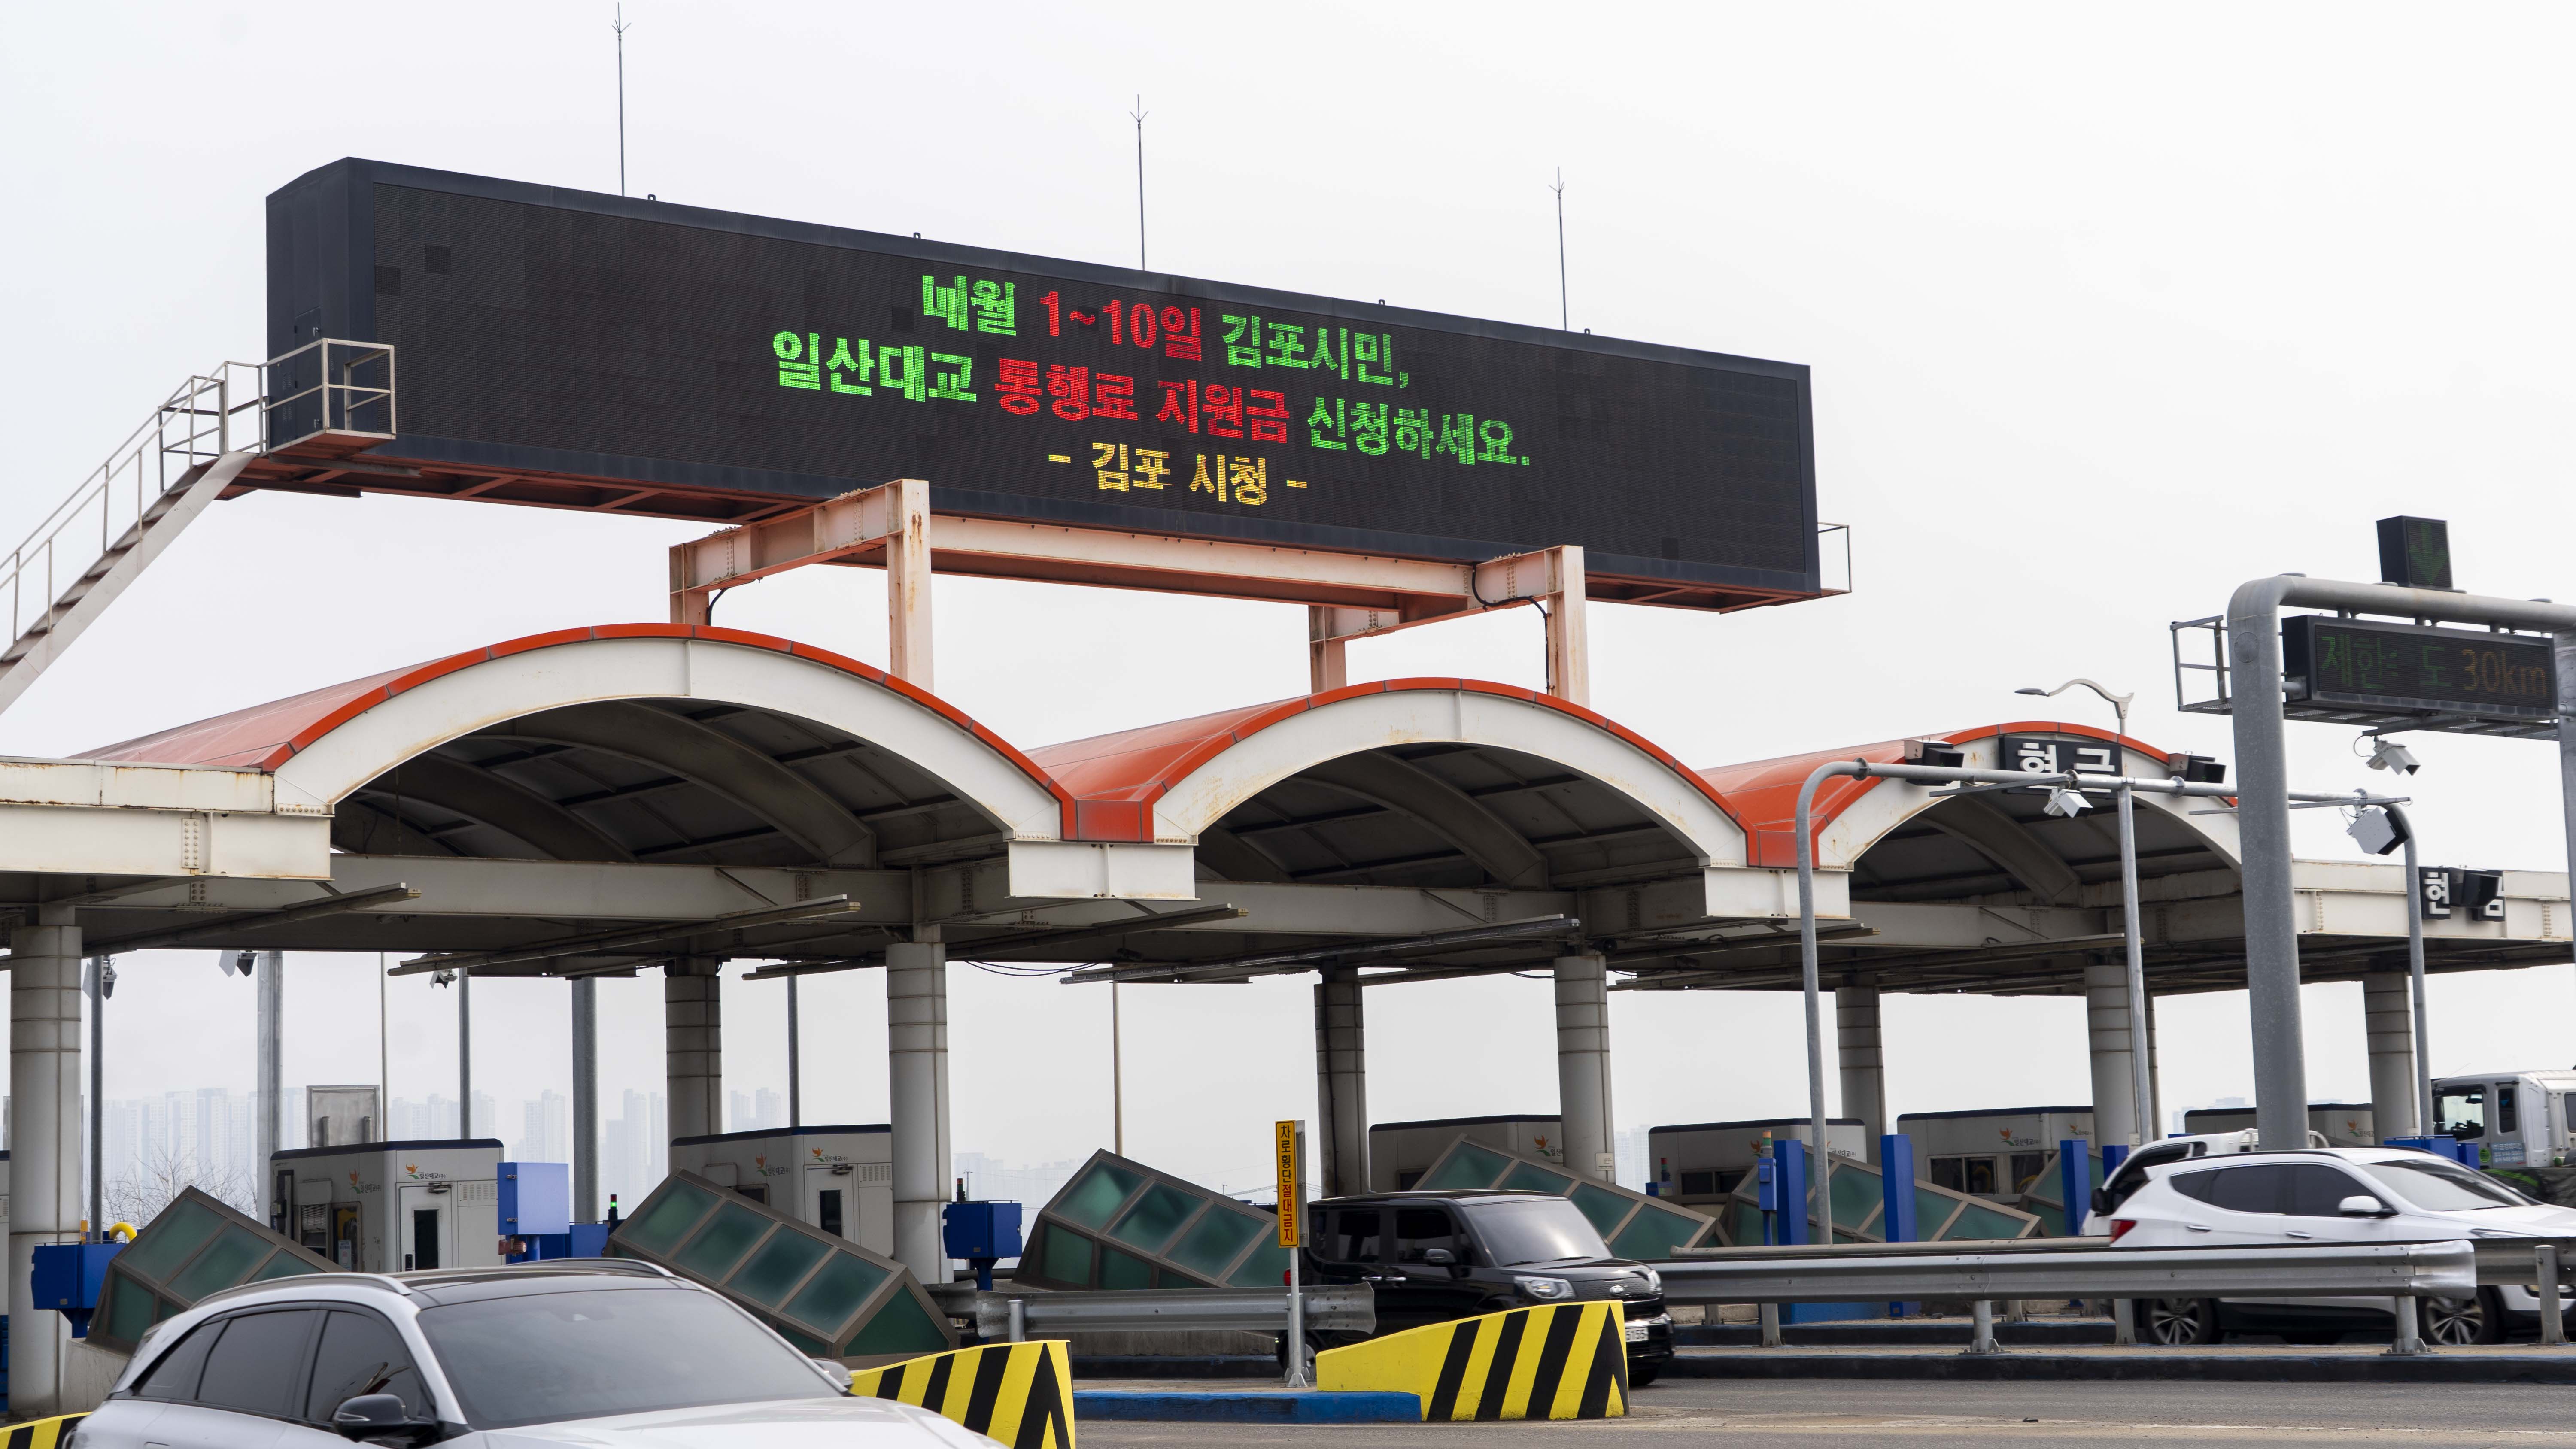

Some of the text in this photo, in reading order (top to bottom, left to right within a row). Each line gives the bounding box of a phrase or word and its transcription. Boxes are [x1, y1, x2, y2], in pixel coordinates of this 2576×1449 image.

[922, 275, 1409, 388] 매월 1~10일 김포시민,
[772, 330, 1530, 466] 일산대교 통행료 지원금 신청하세요.
[1092, 442, 1173, 492] 김포
[1189, 454, 1267, 506] 시청
[2461, 647, 2547, 697] 30km
